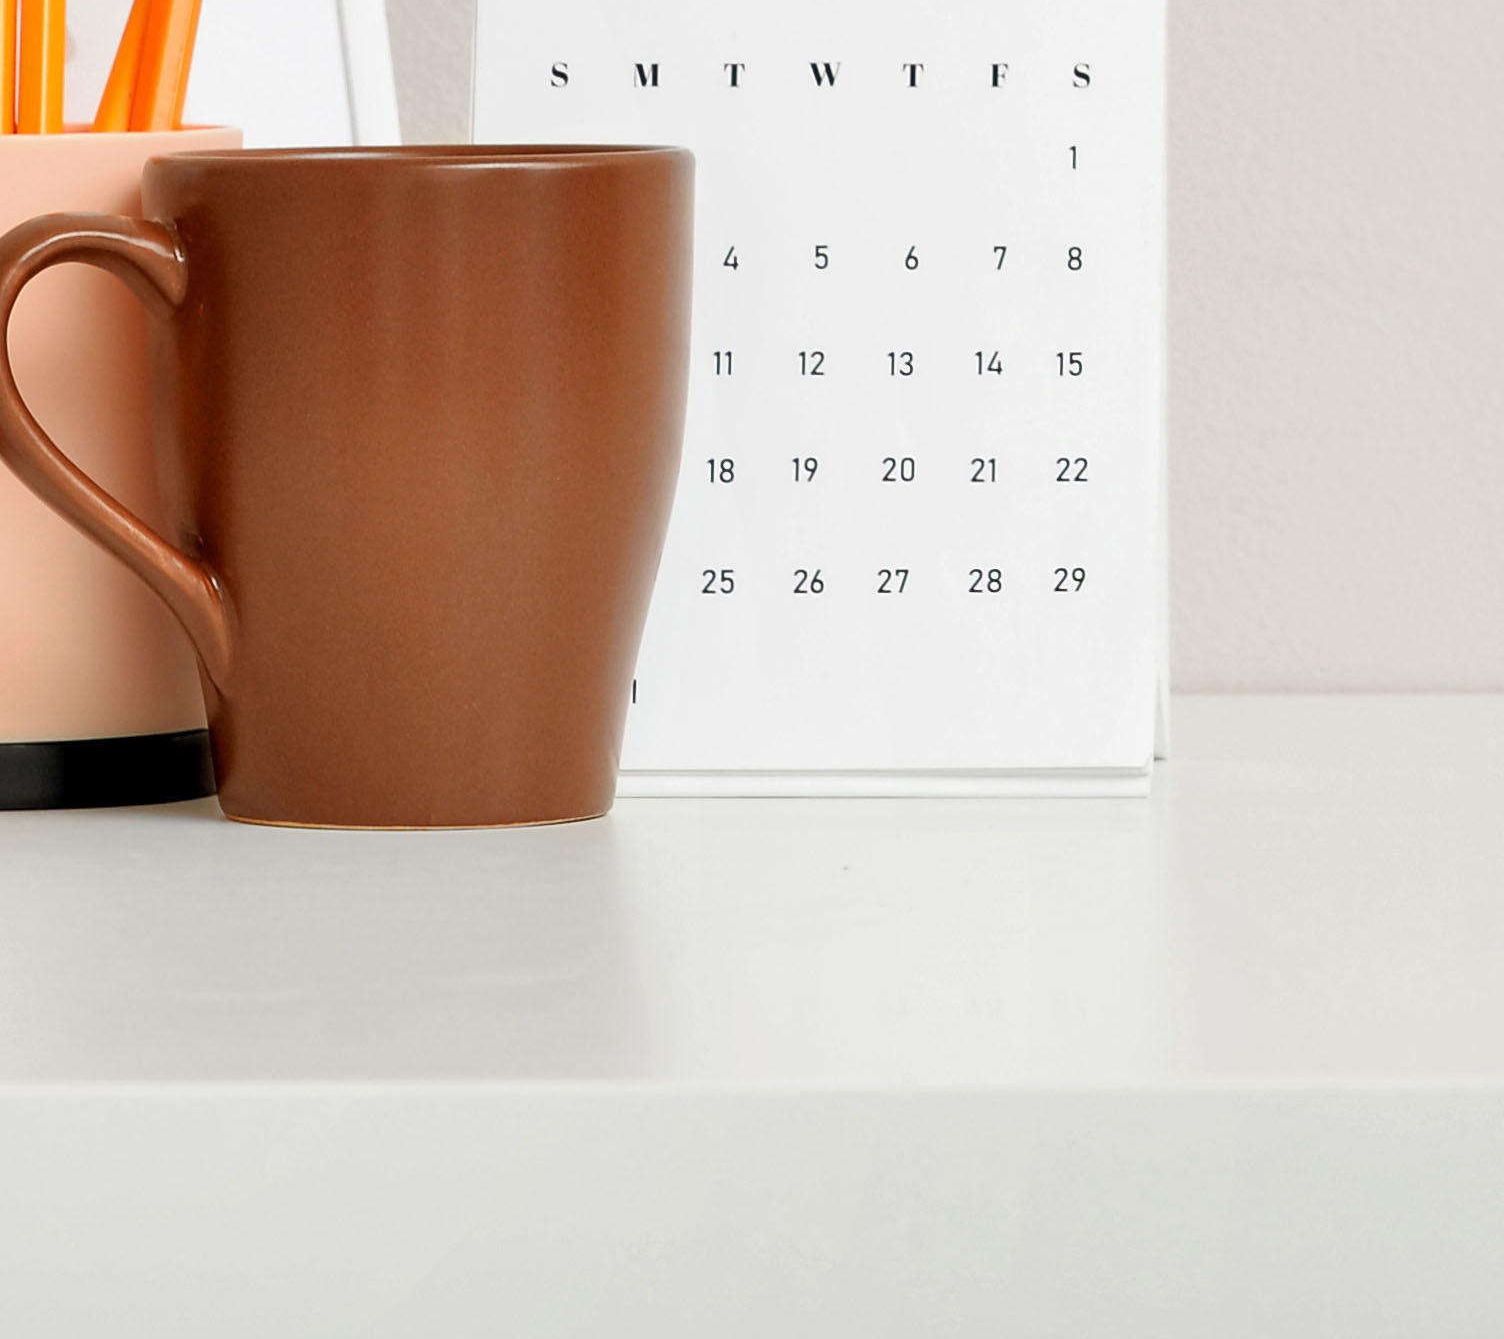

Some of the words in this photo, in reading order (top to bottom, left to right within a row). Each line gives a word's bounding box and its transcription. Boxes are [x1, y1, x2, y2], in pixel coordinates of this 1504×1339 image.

[549, 62, 570, 89] S
[633, 62, 662, 89] M
[723, 62, 746, 89] T
[808, 61, 843, 89] W
[902, 62, 925, 89] T
[989, 62, 1010, 89] F
[1071, 63, 1092, 90] S
[1069, 145, 1077, 170] 1
[722, 246, 739, 271] 4
[814, 244, 829, 270] 5
[904, 245, 919, 271] 6
[993, 245, 1007, 271] 7
[1067, 246, 1083, 271] 8
[713, 350, 732, 376] 11
[798, 351, 825, 376] 12
[887, 351, 914, 377] 13
[975, 351, 1003, 376] 14
[1056, 351, 1083, 377] 15
[707, 458, 735, 484] 18
[792, 457, 818, 482] 19
[882, 457, 915, 482] 20
[970, 457, 996, 483] 21
[1056, 457, 1088, 482] 22
[701, 569, 735, 594] 25
[793, 569, 825, 594] 26
[877, 569, 909, 594] 27
[968, 568, 1002, 593] 28
[1053, 567, 1086, 592] 29
